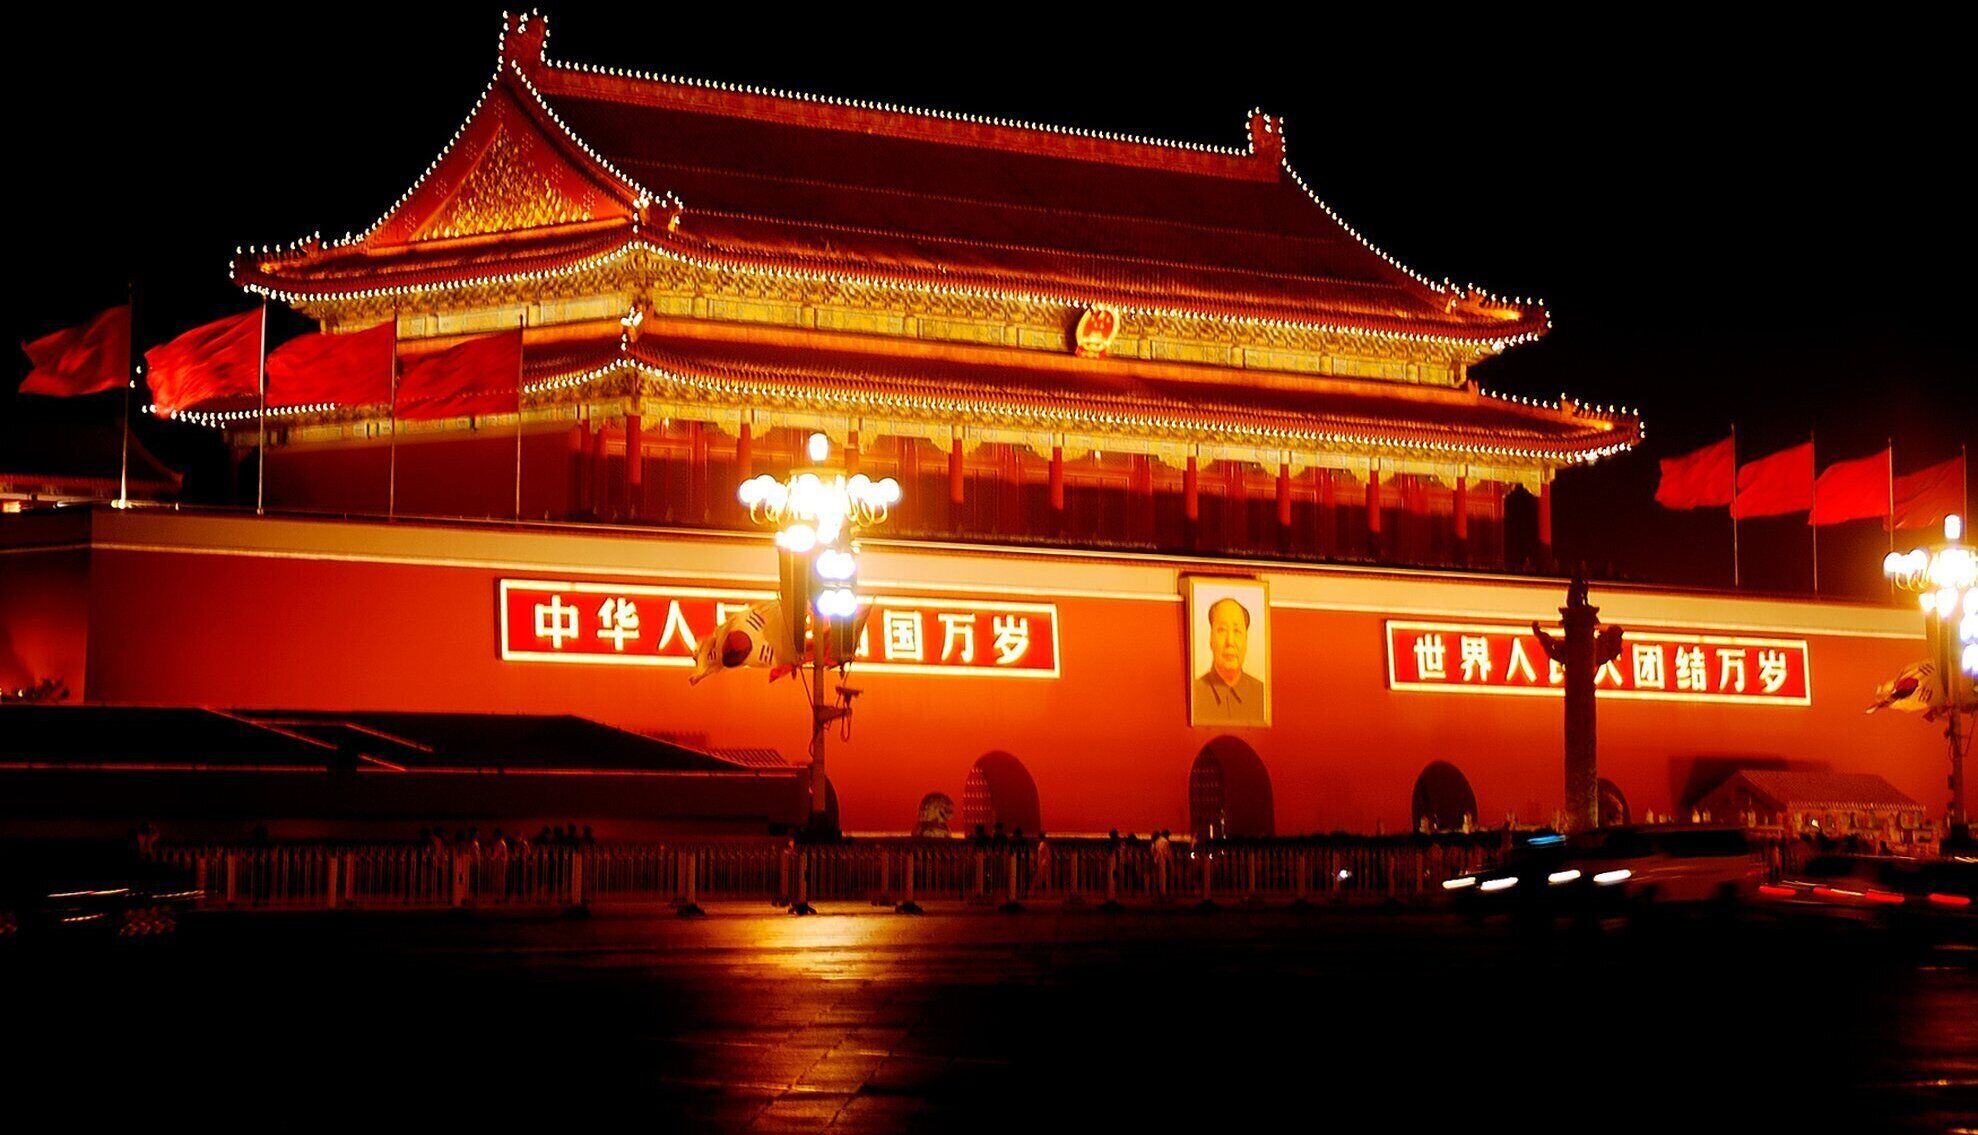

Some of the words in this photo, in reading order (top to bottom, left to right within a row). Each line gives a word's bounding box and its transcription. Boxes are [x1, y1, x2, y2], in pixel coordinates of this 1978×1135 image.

[533, 594, 1030, 665] 中华人国万岁
[1413, 633, 1788, 693] 世界人团结万岁
